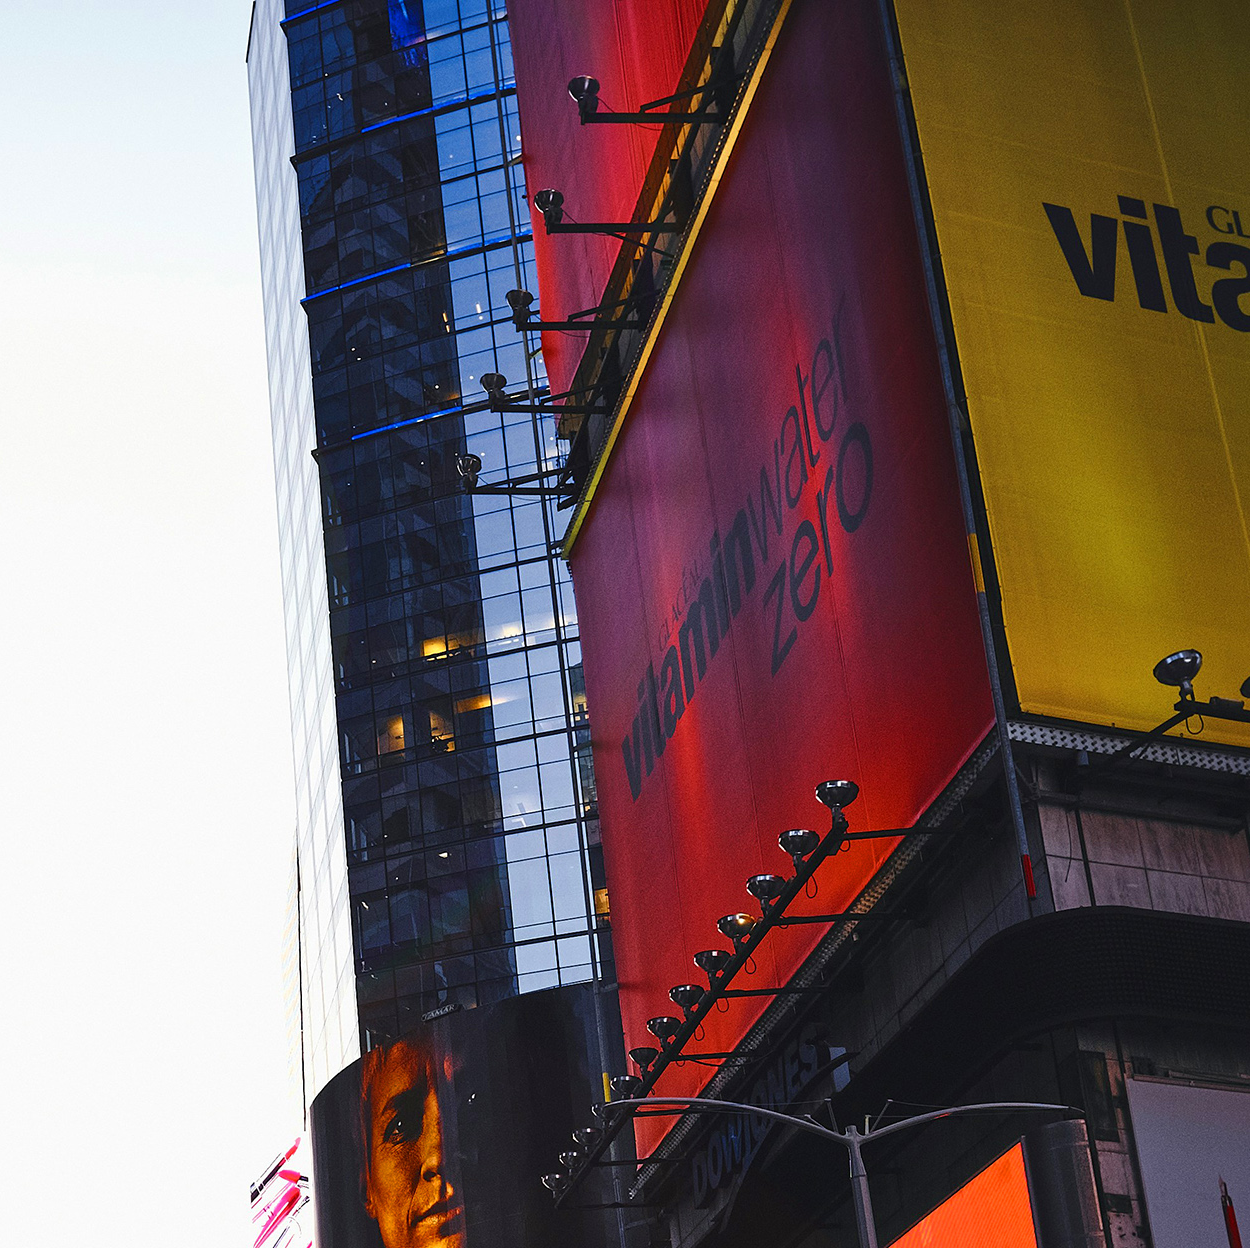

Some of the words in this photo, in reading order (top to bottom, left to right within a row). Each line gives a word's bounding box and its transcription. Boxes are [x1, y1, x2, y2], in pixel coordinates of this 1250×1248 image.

[621, 292, 850, 803] vitaminwater
[764, 422, 874, 678] zero
[692, 1112, 742, 1209] DOW
